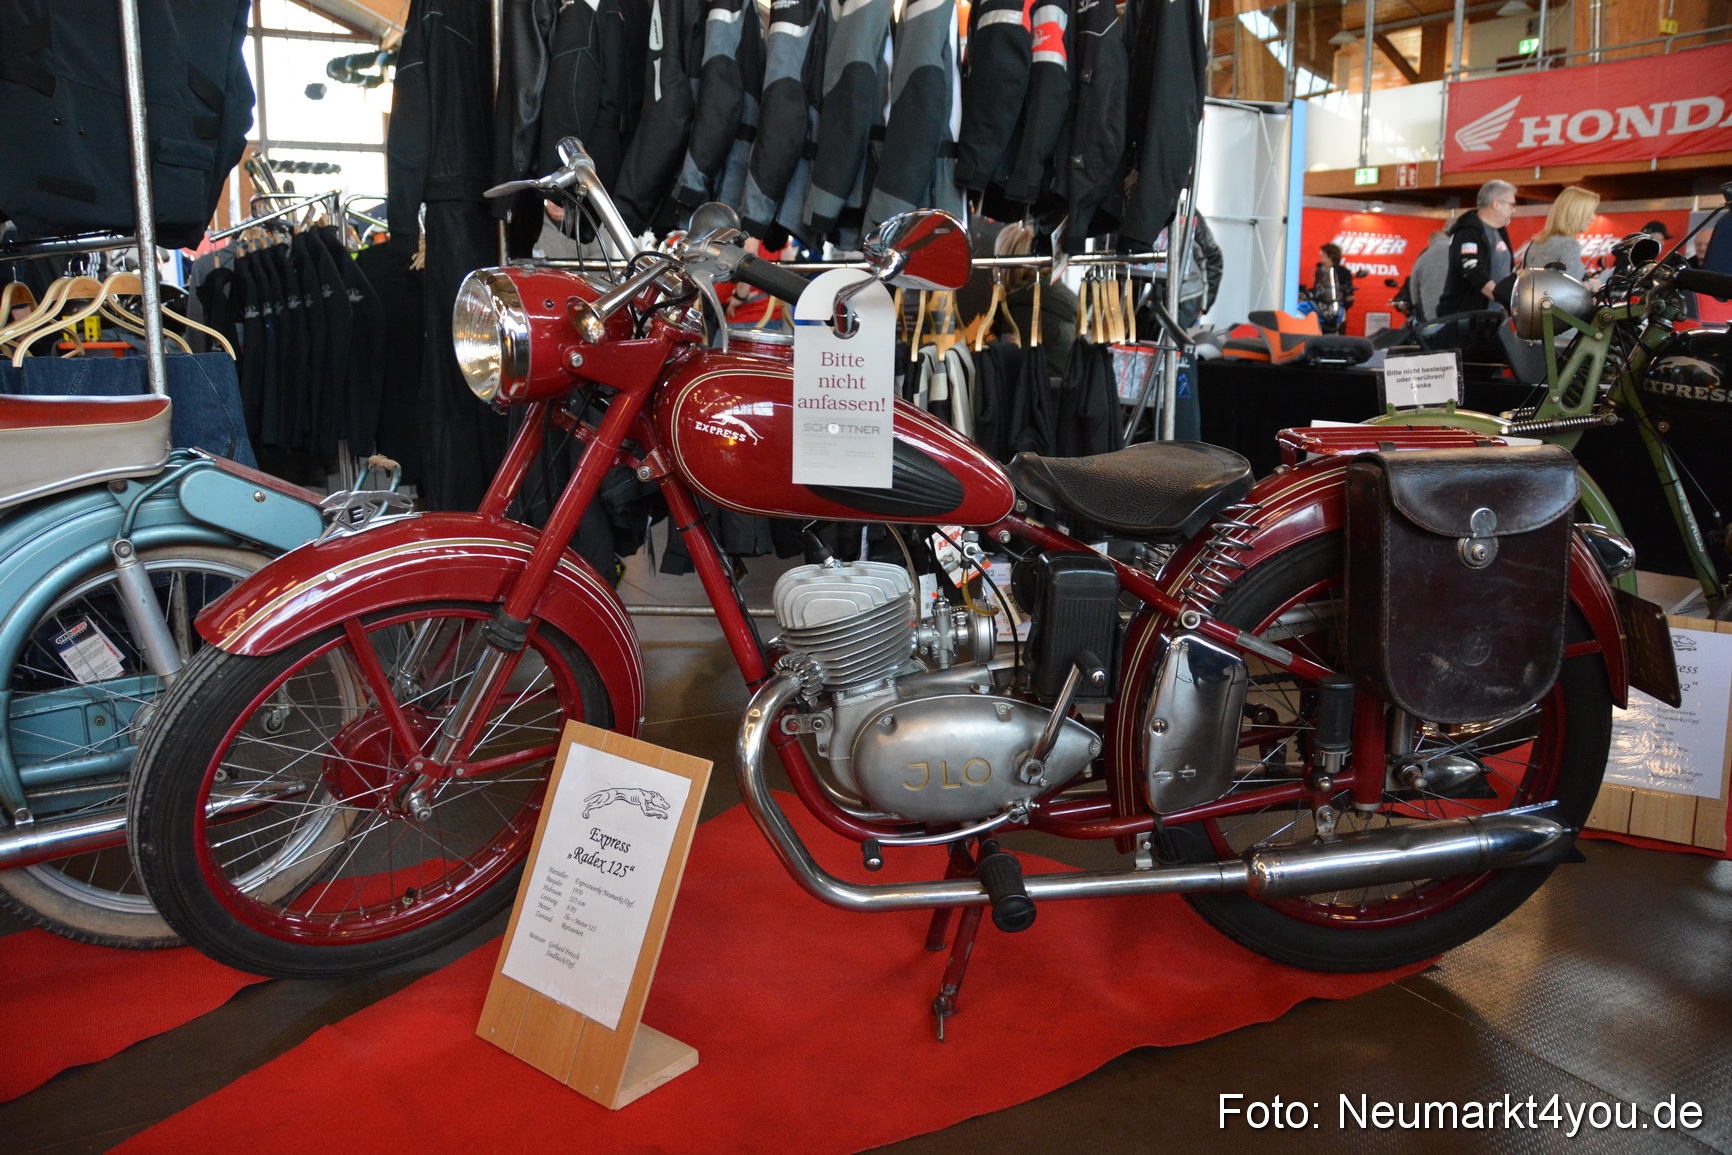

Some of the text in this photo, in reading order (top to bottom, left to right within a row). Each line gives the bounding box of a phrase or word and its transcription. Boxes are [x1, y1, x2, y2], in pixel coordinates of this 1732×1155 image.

[1332, 233, 1408, 256] MEYER
[1346, 261, 1400, 276] HONDA
[820, 351, 865, 368] Bitte
[1386, 364, 1454, 377] Bitte nicht besteigen
[818, 374, 867, 389] nicht
[797, 394, 886, 412] anfassen!
[695, 421, 747, 442] EXPRESS
[803, 422, 880, 435] SCHTTNER
[589, 827, 631, 853] Express
[567, 847, 636, 878] „Radex 125“
